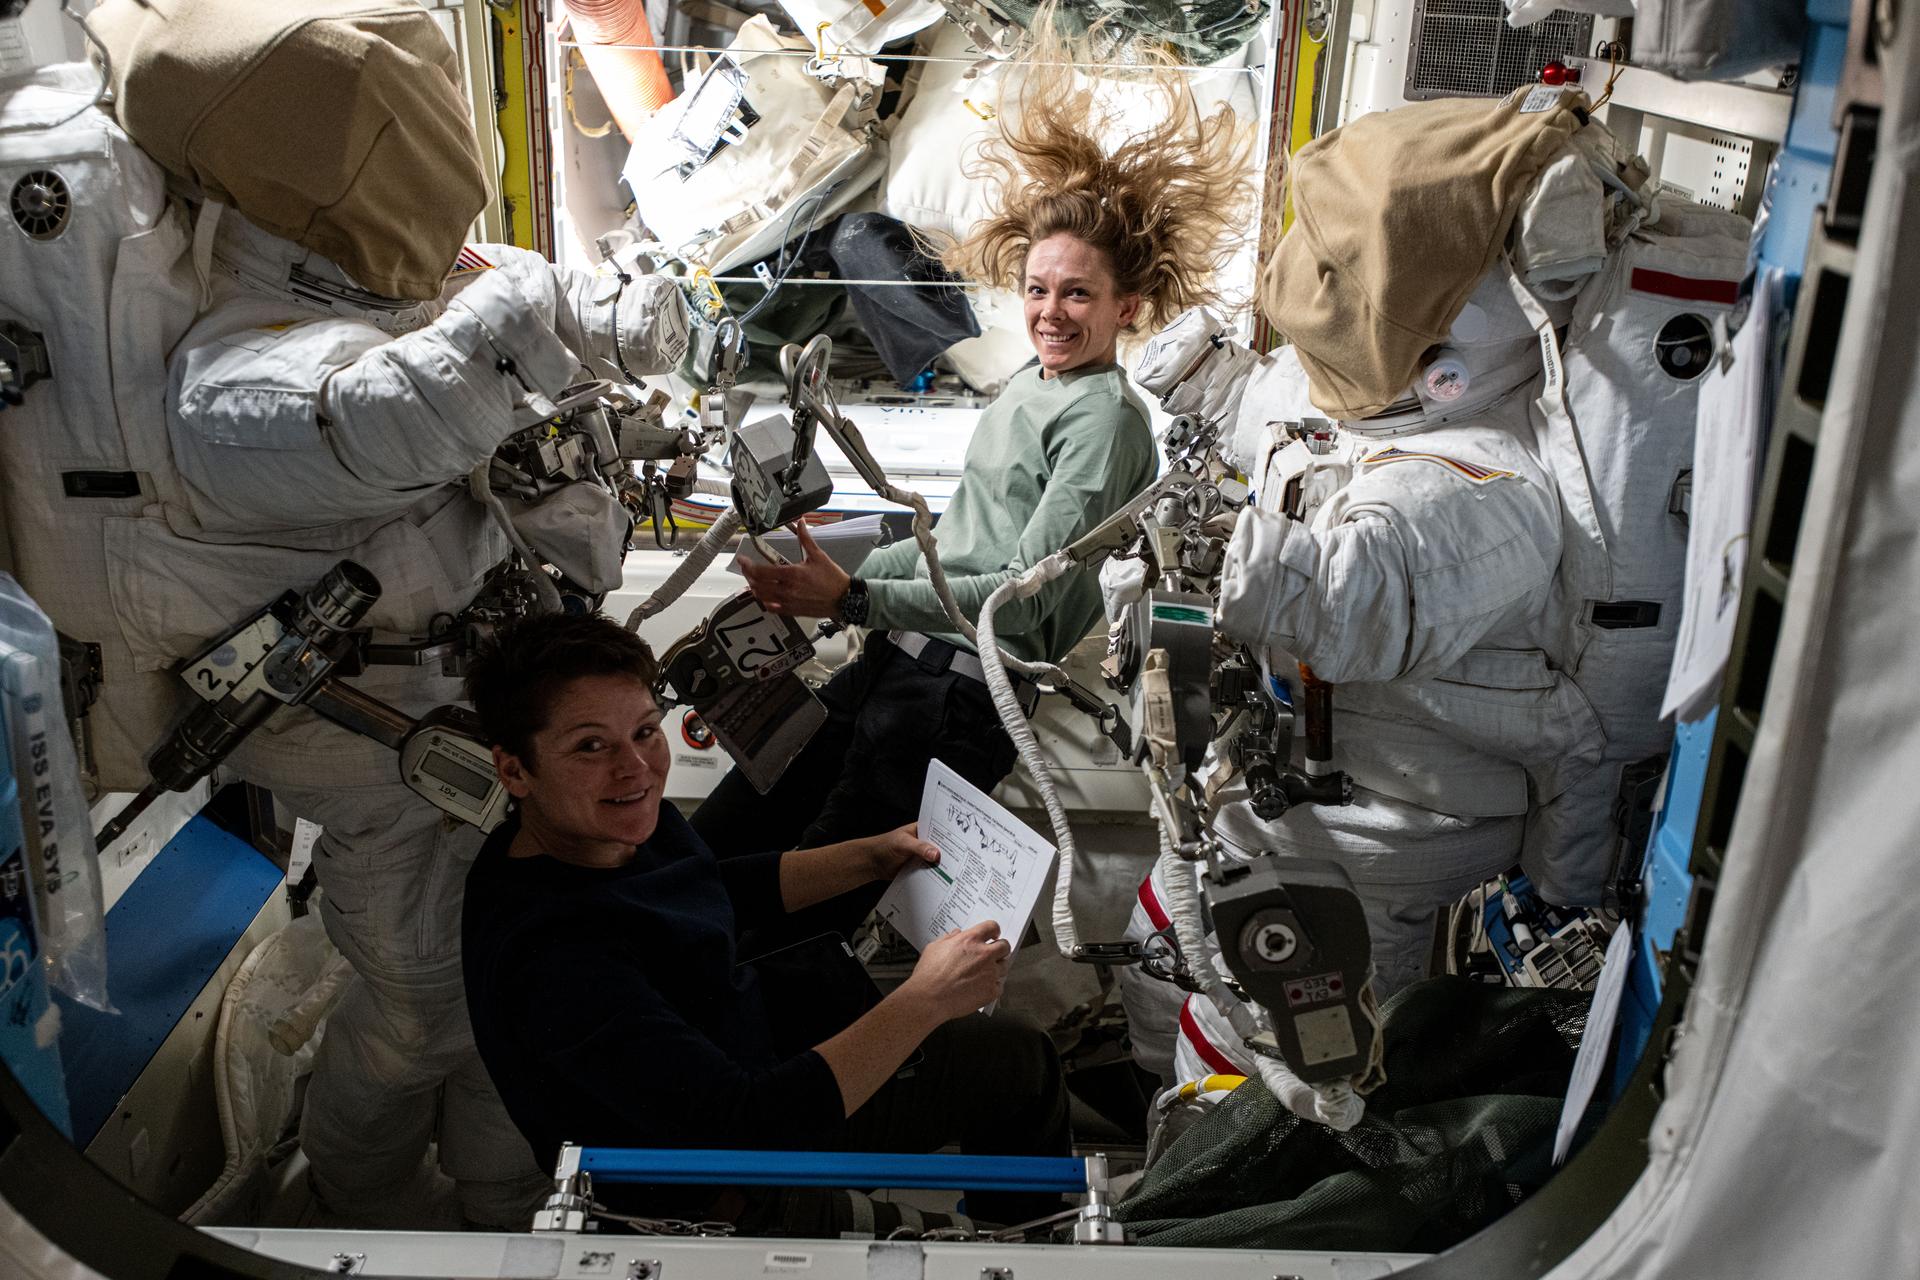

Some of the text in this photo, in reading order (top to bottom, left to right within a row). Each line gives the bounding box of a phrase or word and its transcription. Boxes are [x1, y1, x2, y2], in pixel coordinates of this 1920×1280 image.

[197, 668, 221, 690] 2
[30, 731, 49, 777] ISS
[438, 785, 457, 798] PGT
[36, 786, 54, 838] EVA
